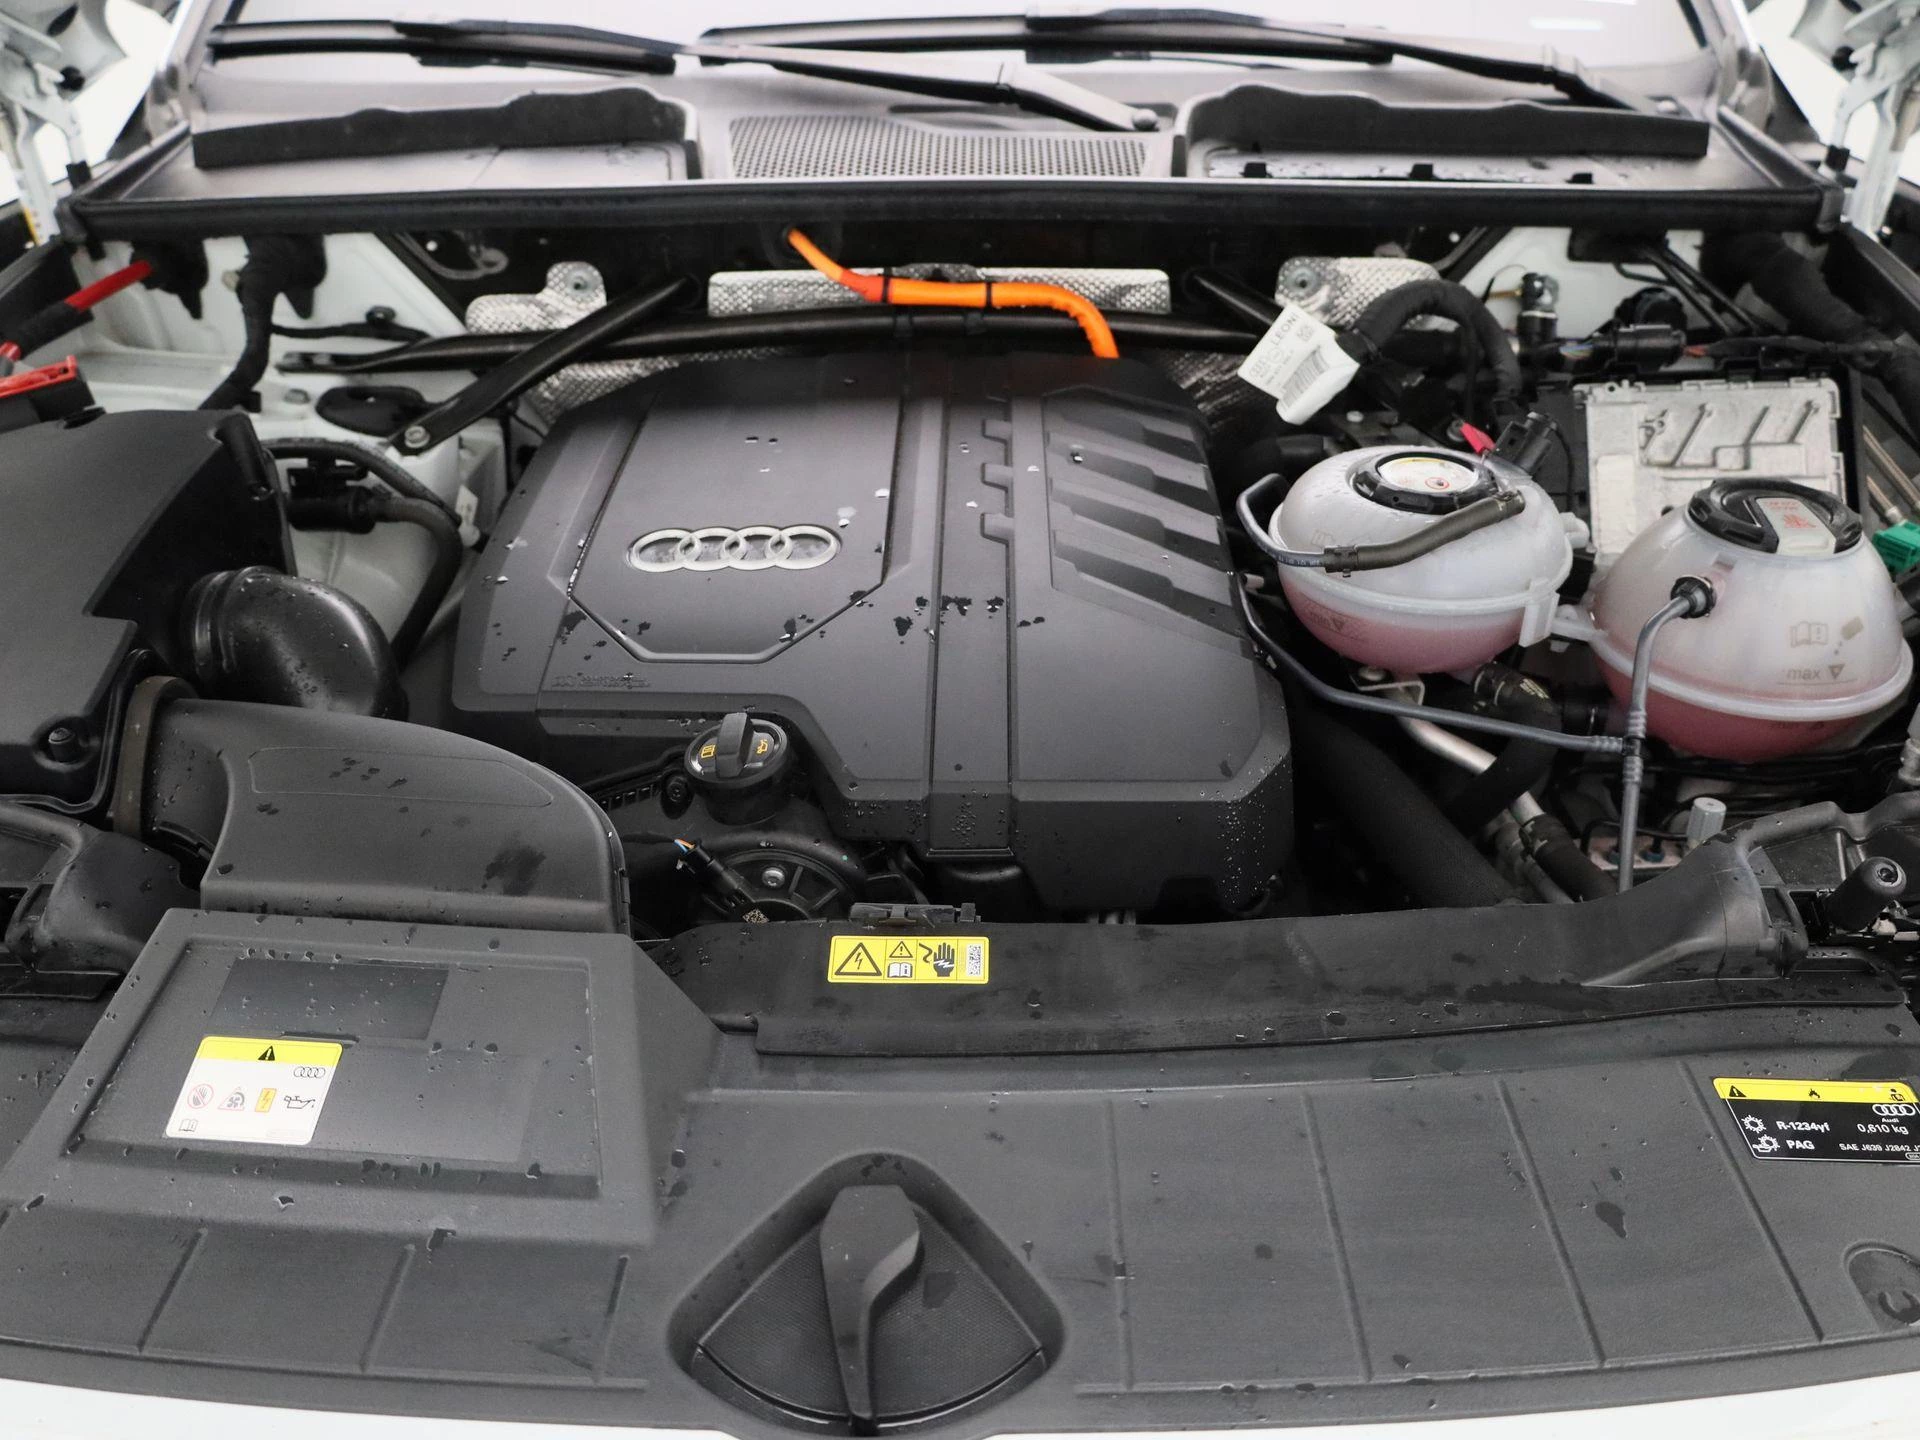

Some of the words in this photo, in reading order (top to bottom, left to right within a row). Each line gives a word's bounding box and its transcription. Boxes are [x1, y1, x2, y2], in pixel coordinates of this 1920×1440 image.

[1271, 311, 1300, 346] LEONI
[1786, 668, 1821, 680] max
[1776, 1121, 1830, 1132] R-1234yf
[1857, 1123, 1890, 1134] 0,610
[1891, 1124, 1909, 1136] kg
[1785, 1140, 1815, 1150] PAG
[1839, 1143, 1859, 1151] SAE
[1861, 1144, 1883, 1152] J639
[1884, 1144, 1911, 1152] J2842
